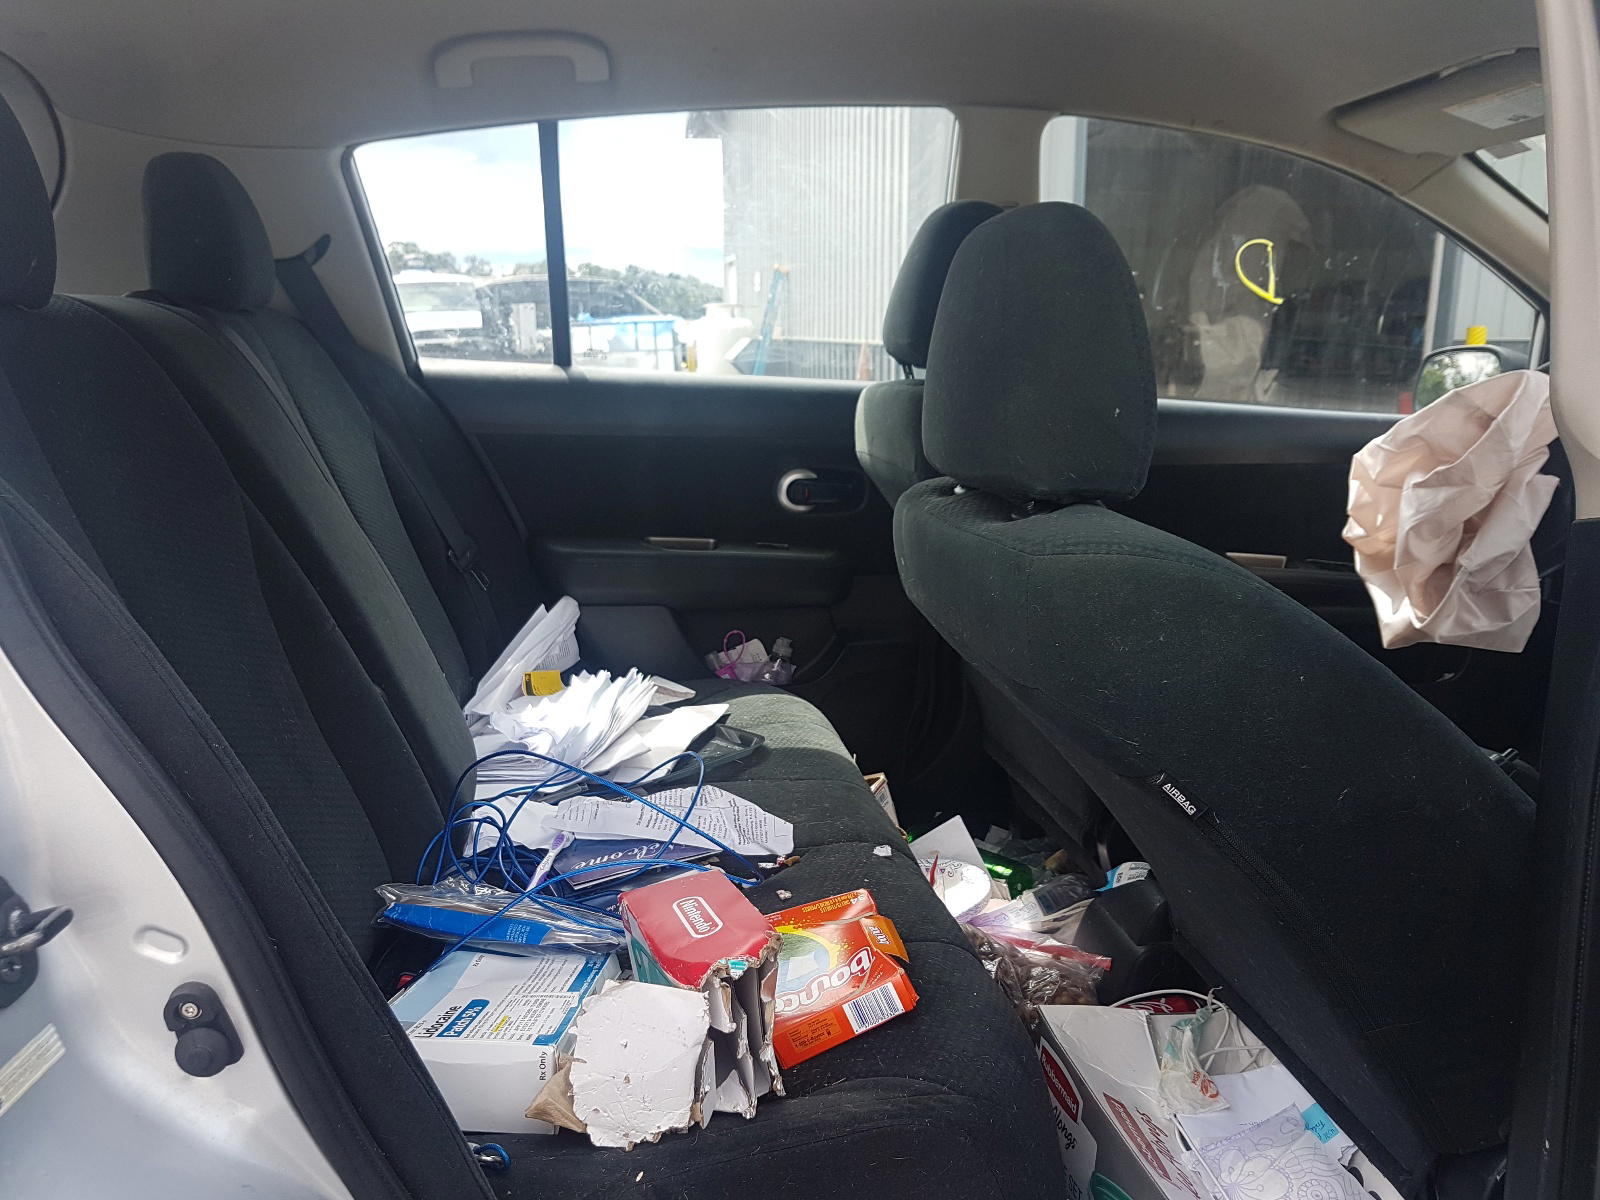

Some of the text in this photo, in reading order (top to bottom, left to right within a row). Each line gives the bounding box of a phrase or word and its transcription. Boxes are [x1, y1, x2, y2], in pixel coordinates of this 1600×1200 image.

[1162, 783, 1197, 815] AIRBAG
[570, 842, 675, 870] elcome
[679, 900, 713, 933] Nintendo
[415, 1005, 463, 1038] Lidocaine
[444, 1014, 472, 1037] Patch
[538, 1051, 548, 1081] Rx Only
[1041, 1053, 1077, 1115] Rubbermaid
